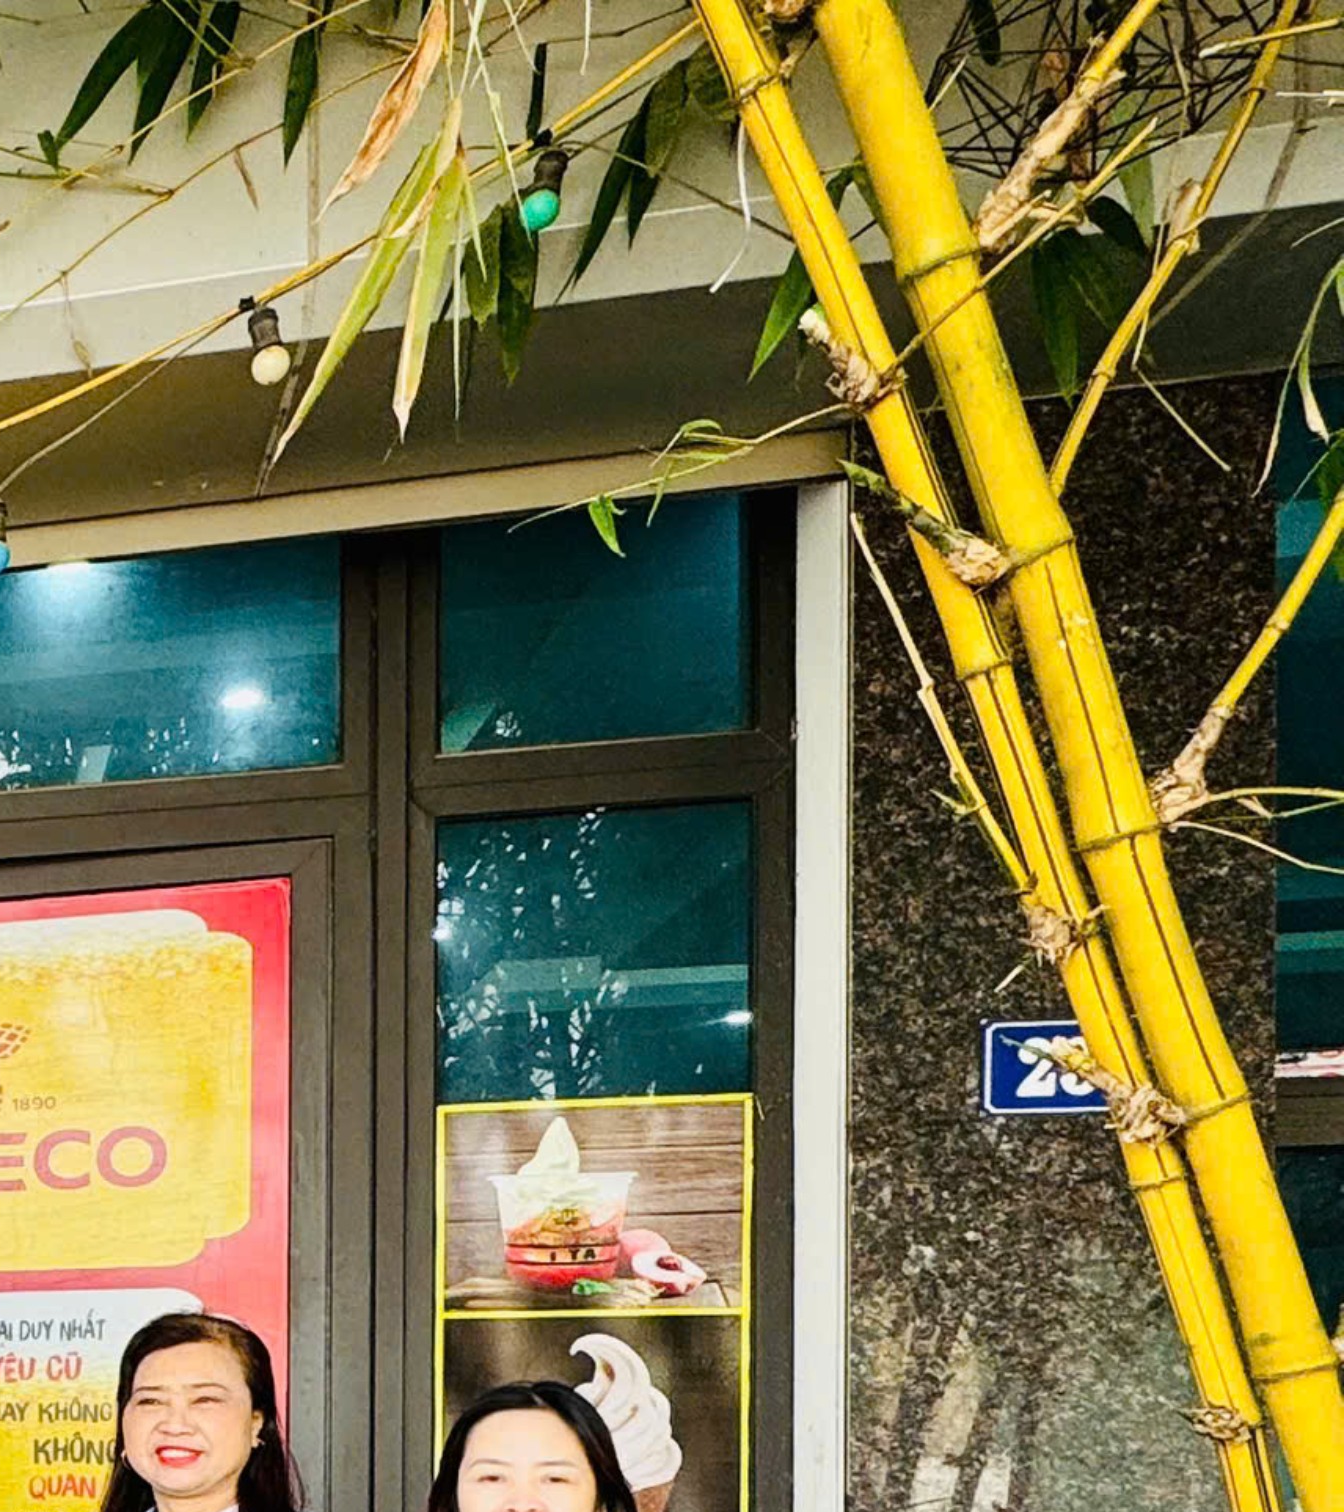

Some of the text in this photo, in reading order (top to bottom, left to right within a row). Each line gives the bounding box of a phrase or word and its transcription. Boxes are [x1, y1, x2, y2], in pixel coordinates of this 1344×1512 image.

[12, 1095, 57, 1112] 1890
[19, 1319, 55, 1342] DUY
[59, 1308, 106, 1342] NHẤT
[46, 1350, 83, 1382] CŨ
[38, 1397, 113, 1424] KHÔNG
